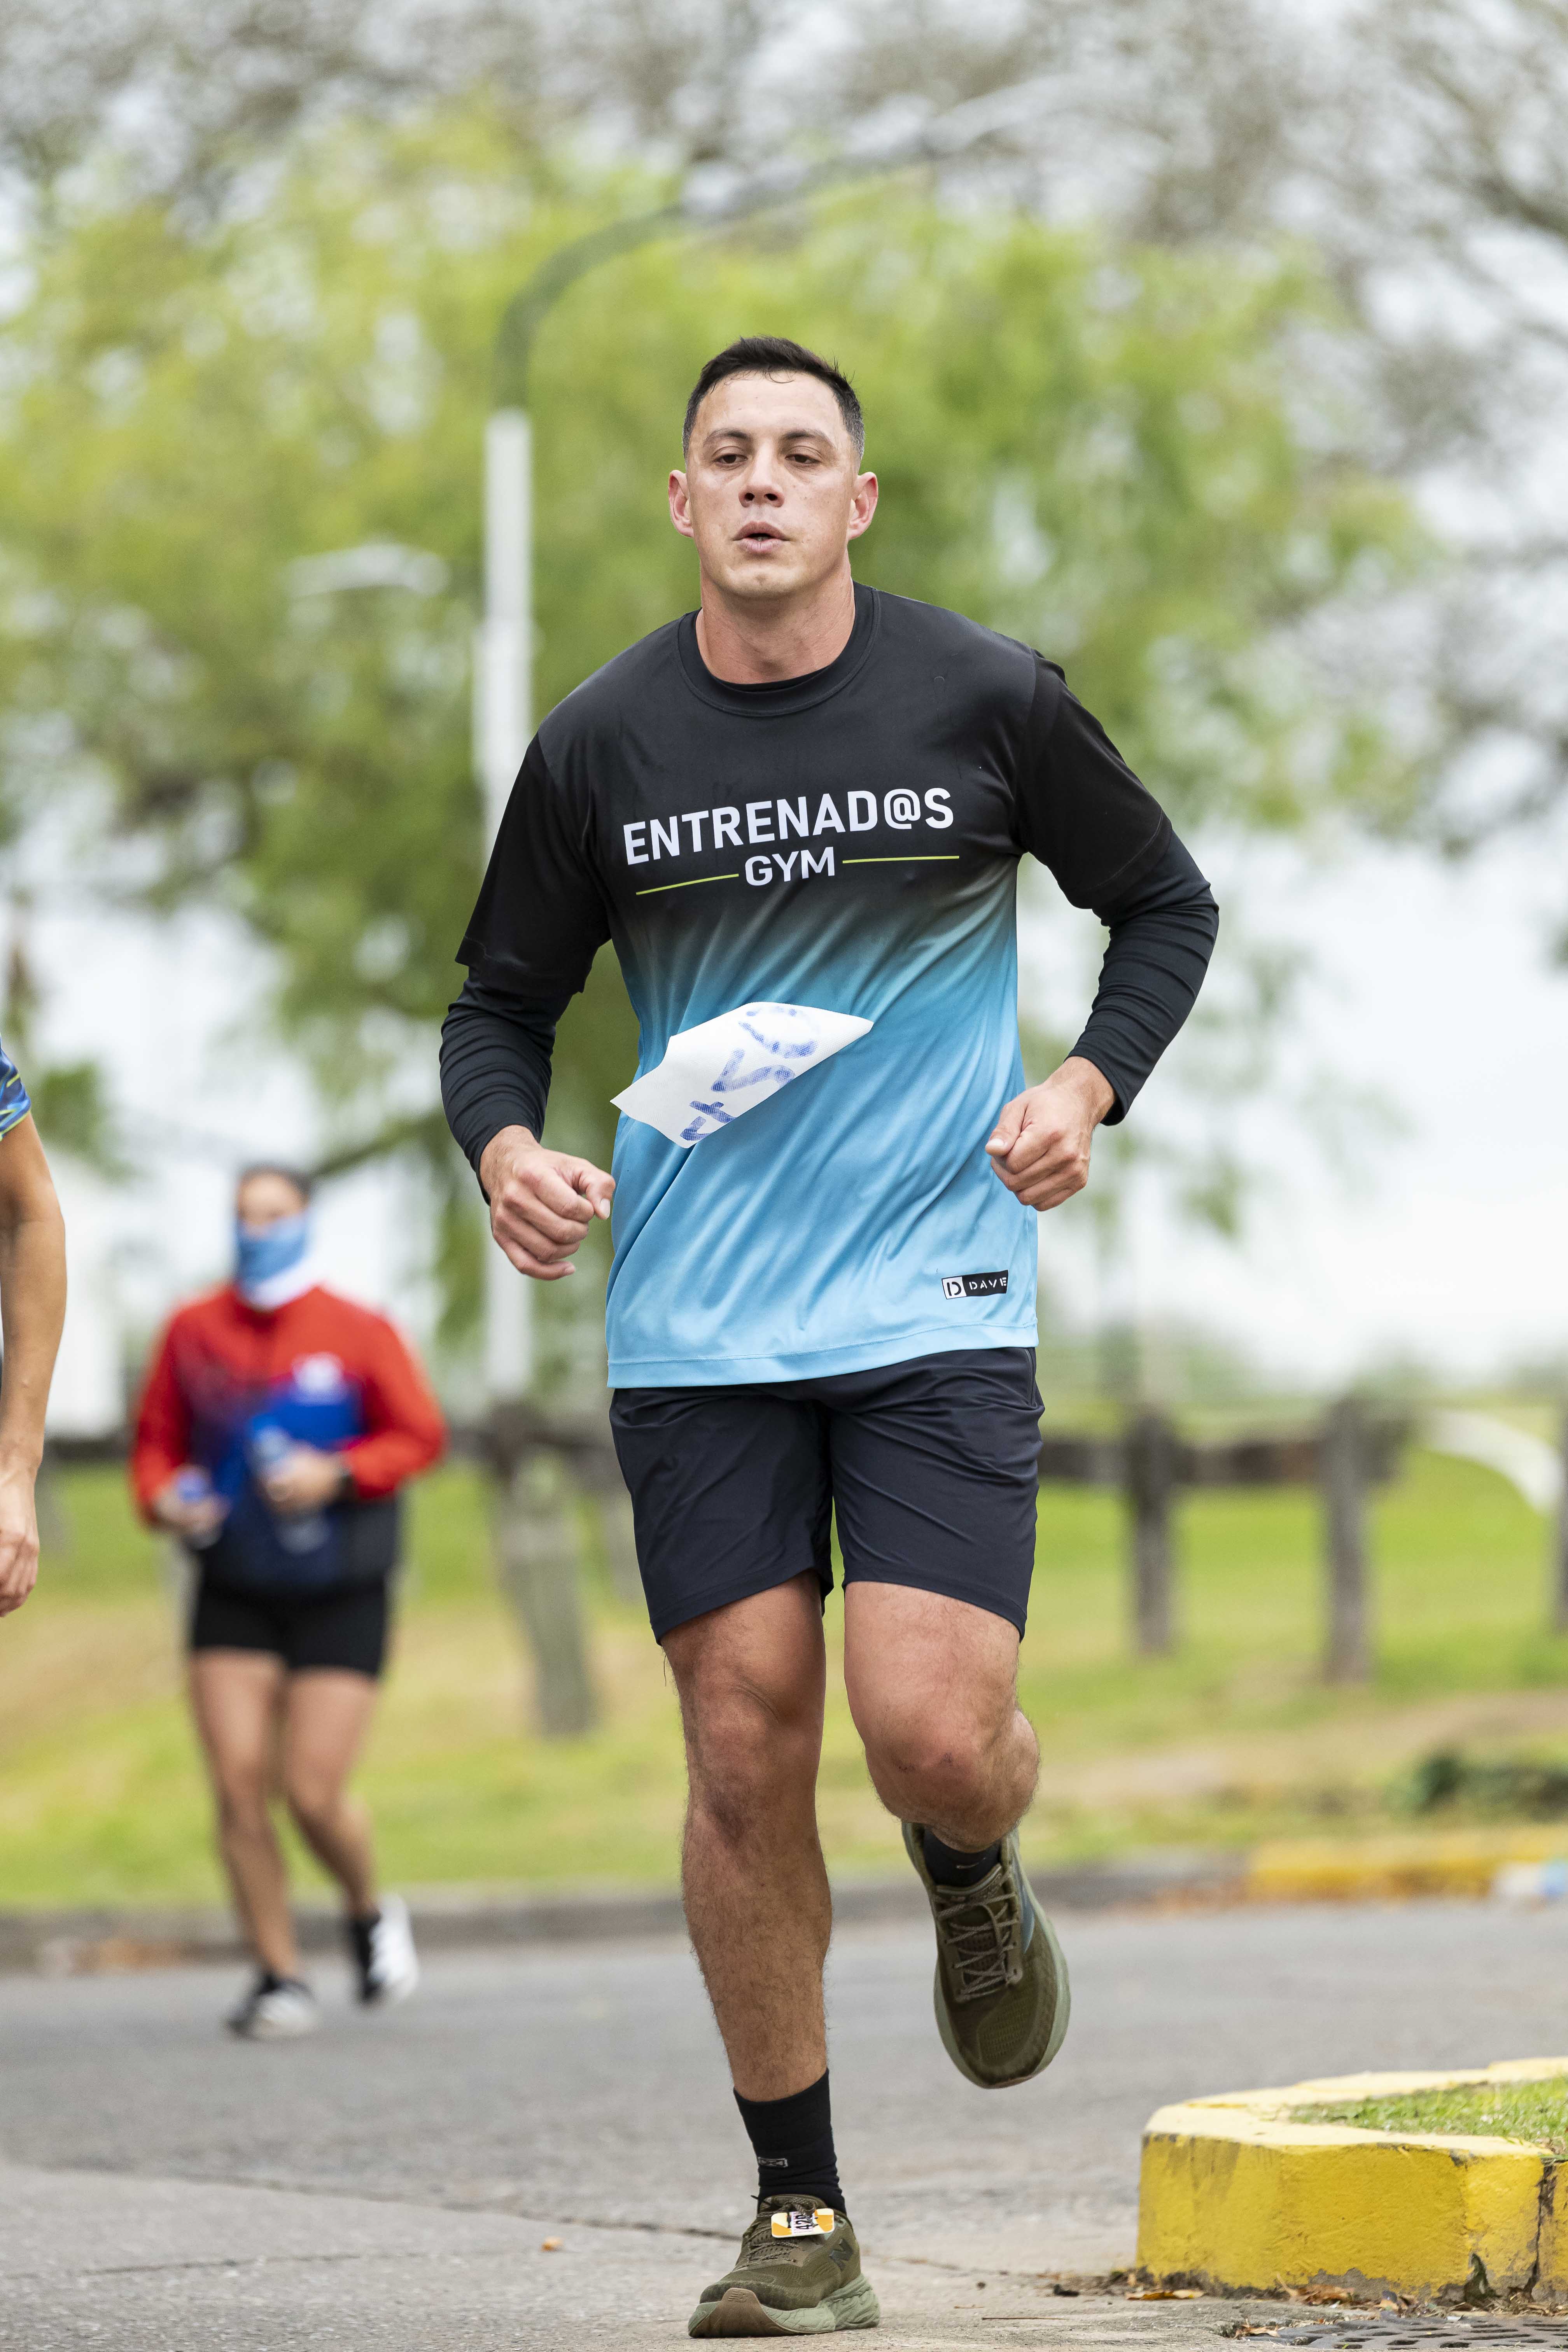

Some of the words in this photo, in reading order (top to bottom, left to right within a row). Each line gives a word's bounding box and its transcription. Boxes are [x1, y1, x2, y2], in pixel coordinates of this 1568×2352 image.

[623, 788, 954, 865] ENTRENAD@S
[745, 846, 835, 886] GYM
[969, 1277, 1007, 1290] DAVE
